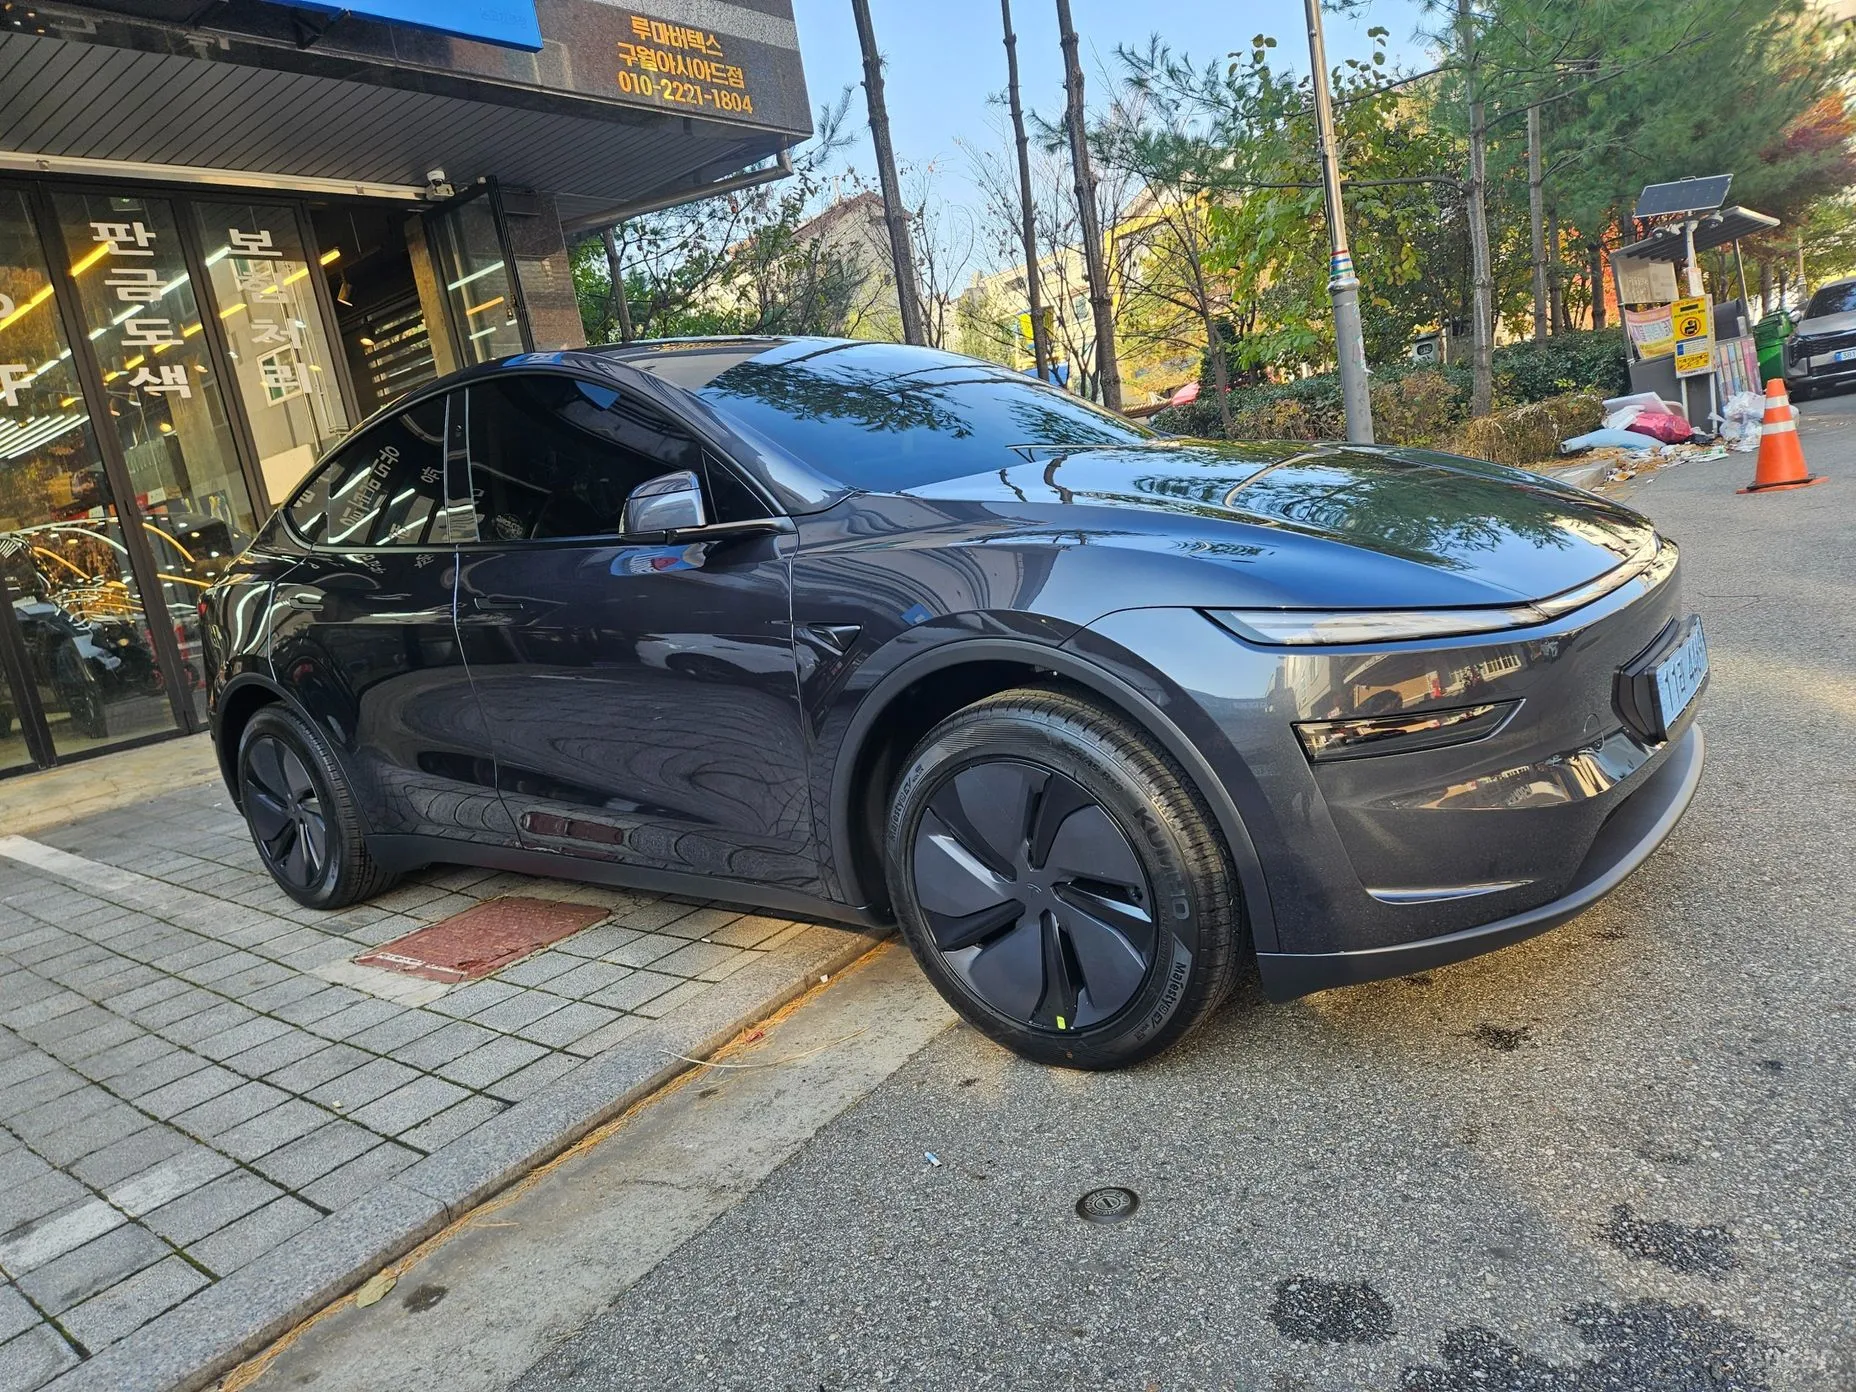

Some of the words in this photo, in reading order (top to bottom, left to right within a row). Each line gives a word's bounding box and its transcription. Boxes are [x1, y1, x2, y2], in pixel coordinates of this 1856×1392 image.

[630, 15, 723, 57] 루마버텍스
[617, 41, 745, 89] 구월아시아드점
[618, 70, 753, 114] 010-2221-1804
[90, 222, 192, 398] 판금도색
[229, 228, 313, 394] 보험처리
